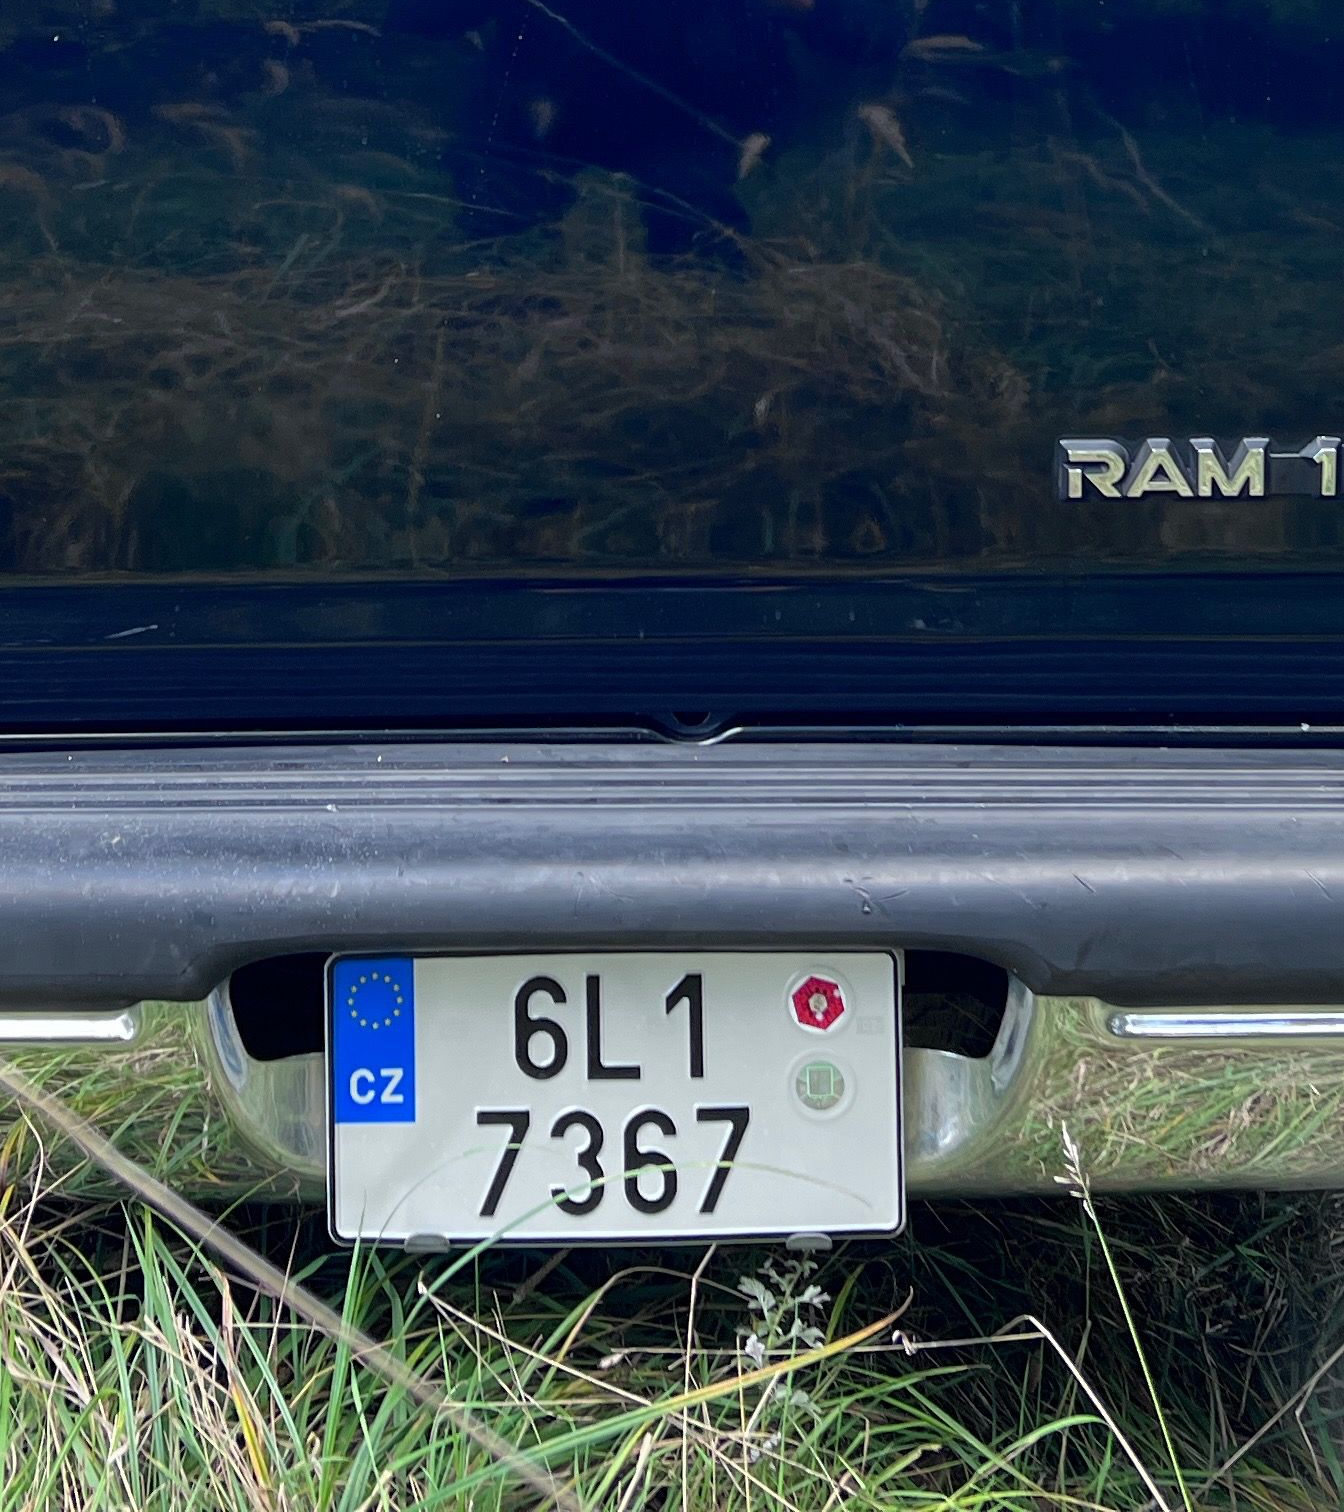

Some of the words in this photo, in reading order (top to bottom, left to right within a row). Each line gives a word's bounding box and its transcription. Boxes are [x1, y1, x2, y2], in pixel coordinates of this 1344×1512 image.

[1059, 437, 1270, 498] RAM
[514, 973, 704, 1080] 6L1
[349, 1067, 404, 1104] CZ
[476, 1107, 751, 1217] 7367
